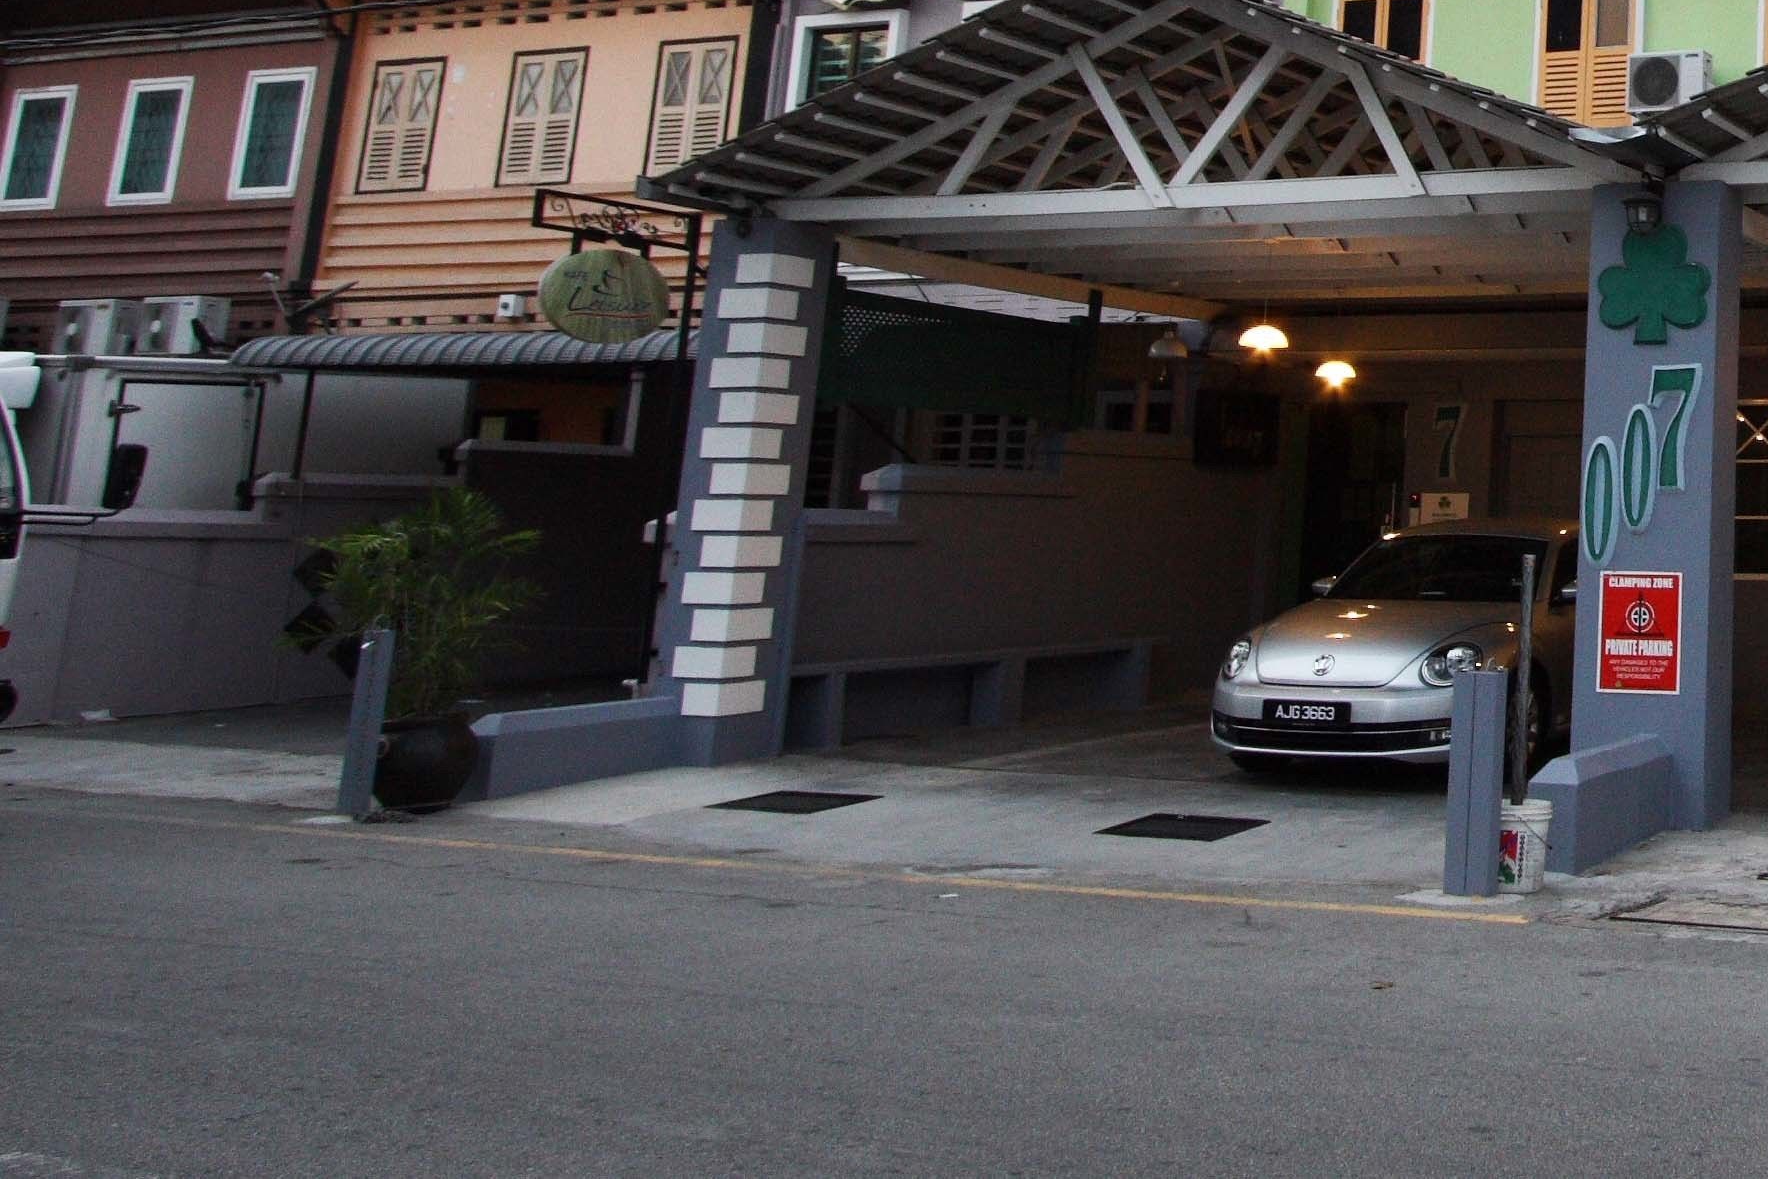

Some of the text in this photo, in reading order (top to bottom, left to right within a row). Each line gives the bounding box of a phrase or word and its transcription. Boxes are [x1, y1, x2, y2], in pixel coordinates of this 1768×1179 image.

[1434, 406, 1461, 478] 7
[1583, 363, 1703, 566] 007
[1609, 576, 1674, 589] CLAMPING ZONE
[1605, 639, 1673, 657] PRIVATE PARKING
